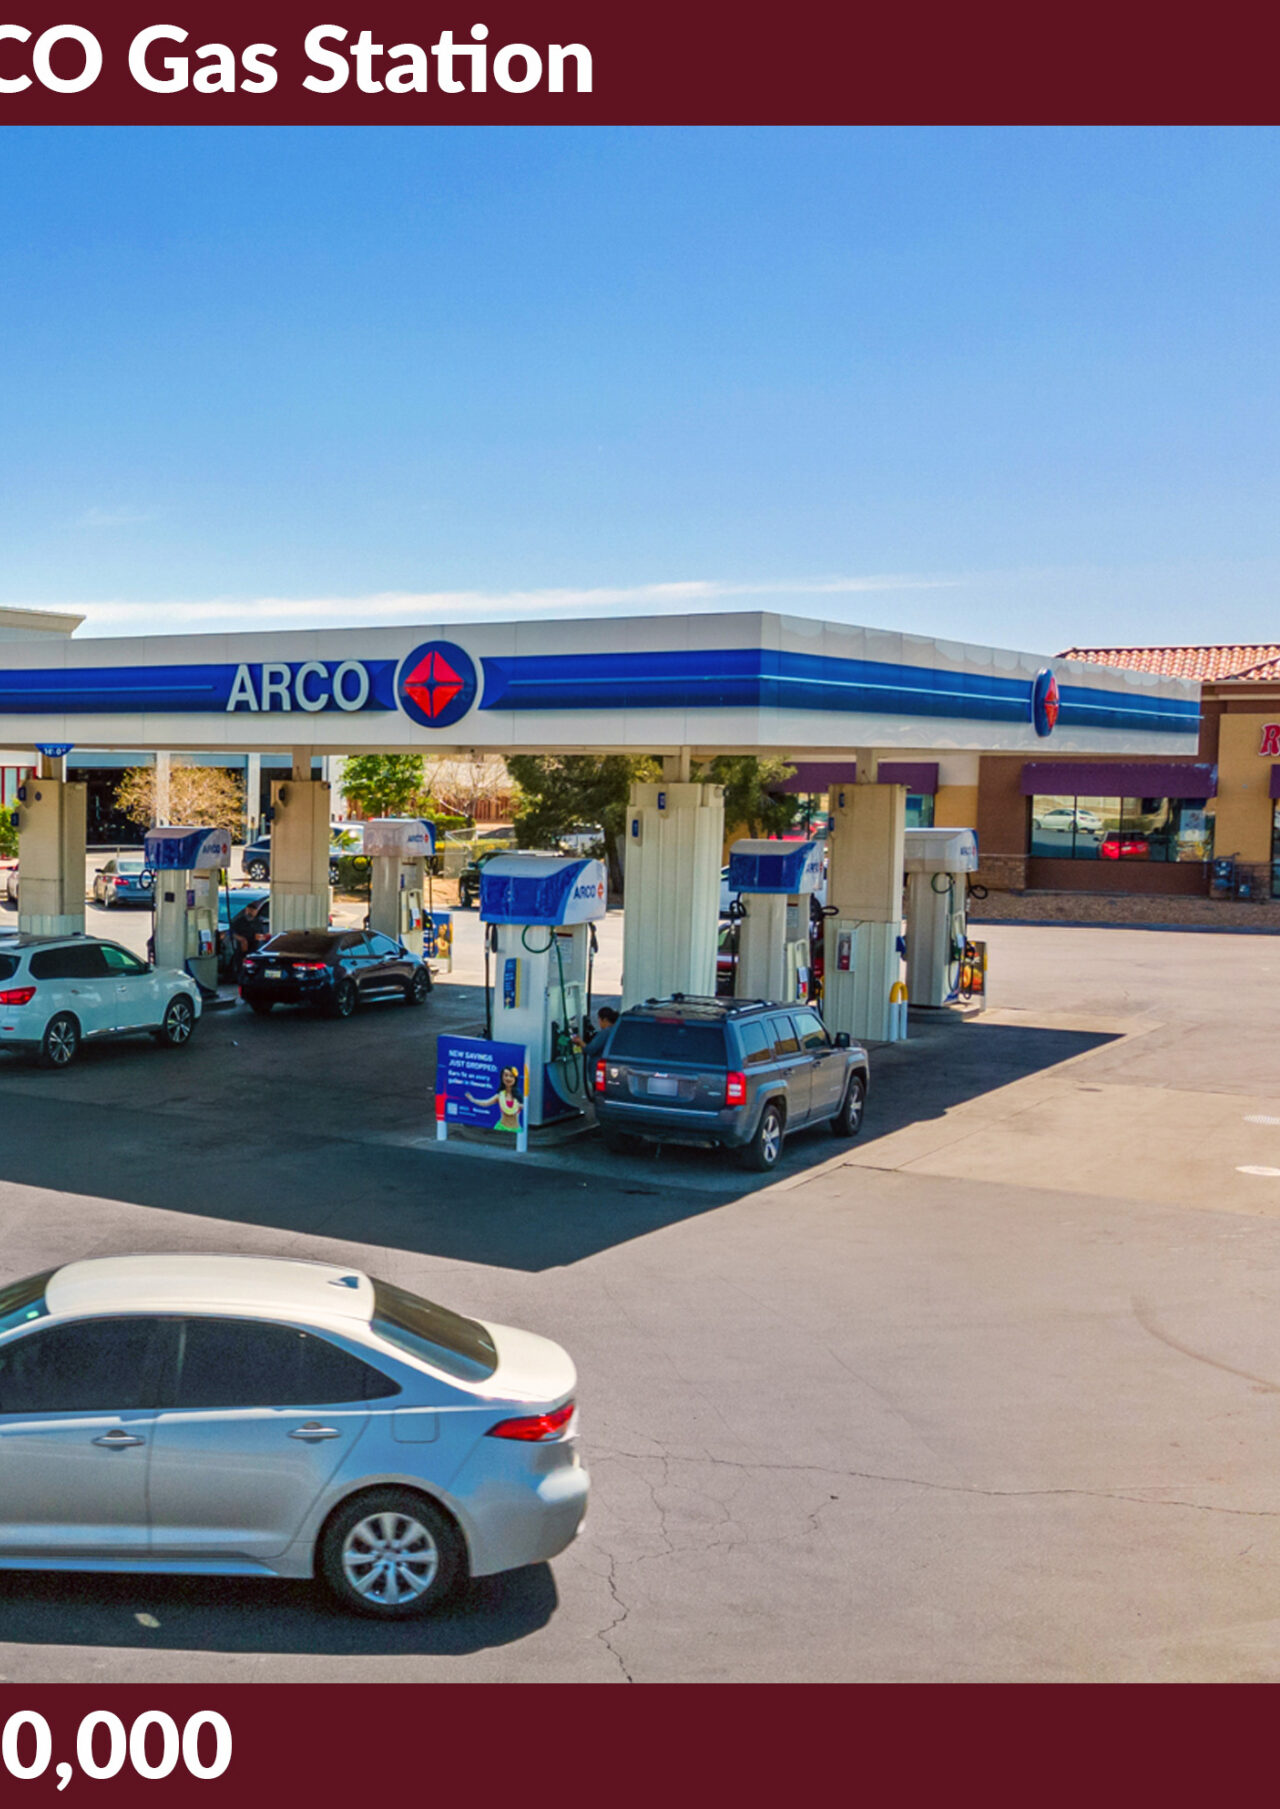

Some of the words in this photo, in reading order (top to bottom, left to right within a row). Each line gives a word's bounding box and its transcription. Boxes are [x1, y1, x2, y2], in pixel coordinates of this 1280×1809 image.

[226, 661, 369, 712] ARCO
[573, 884, 596, 900] ARCO
[448, 1049, 464, 1058] NEW
[465, 1051, 493, 1062] SAVINGS
[449, 1059, 465, 1067] JUST
